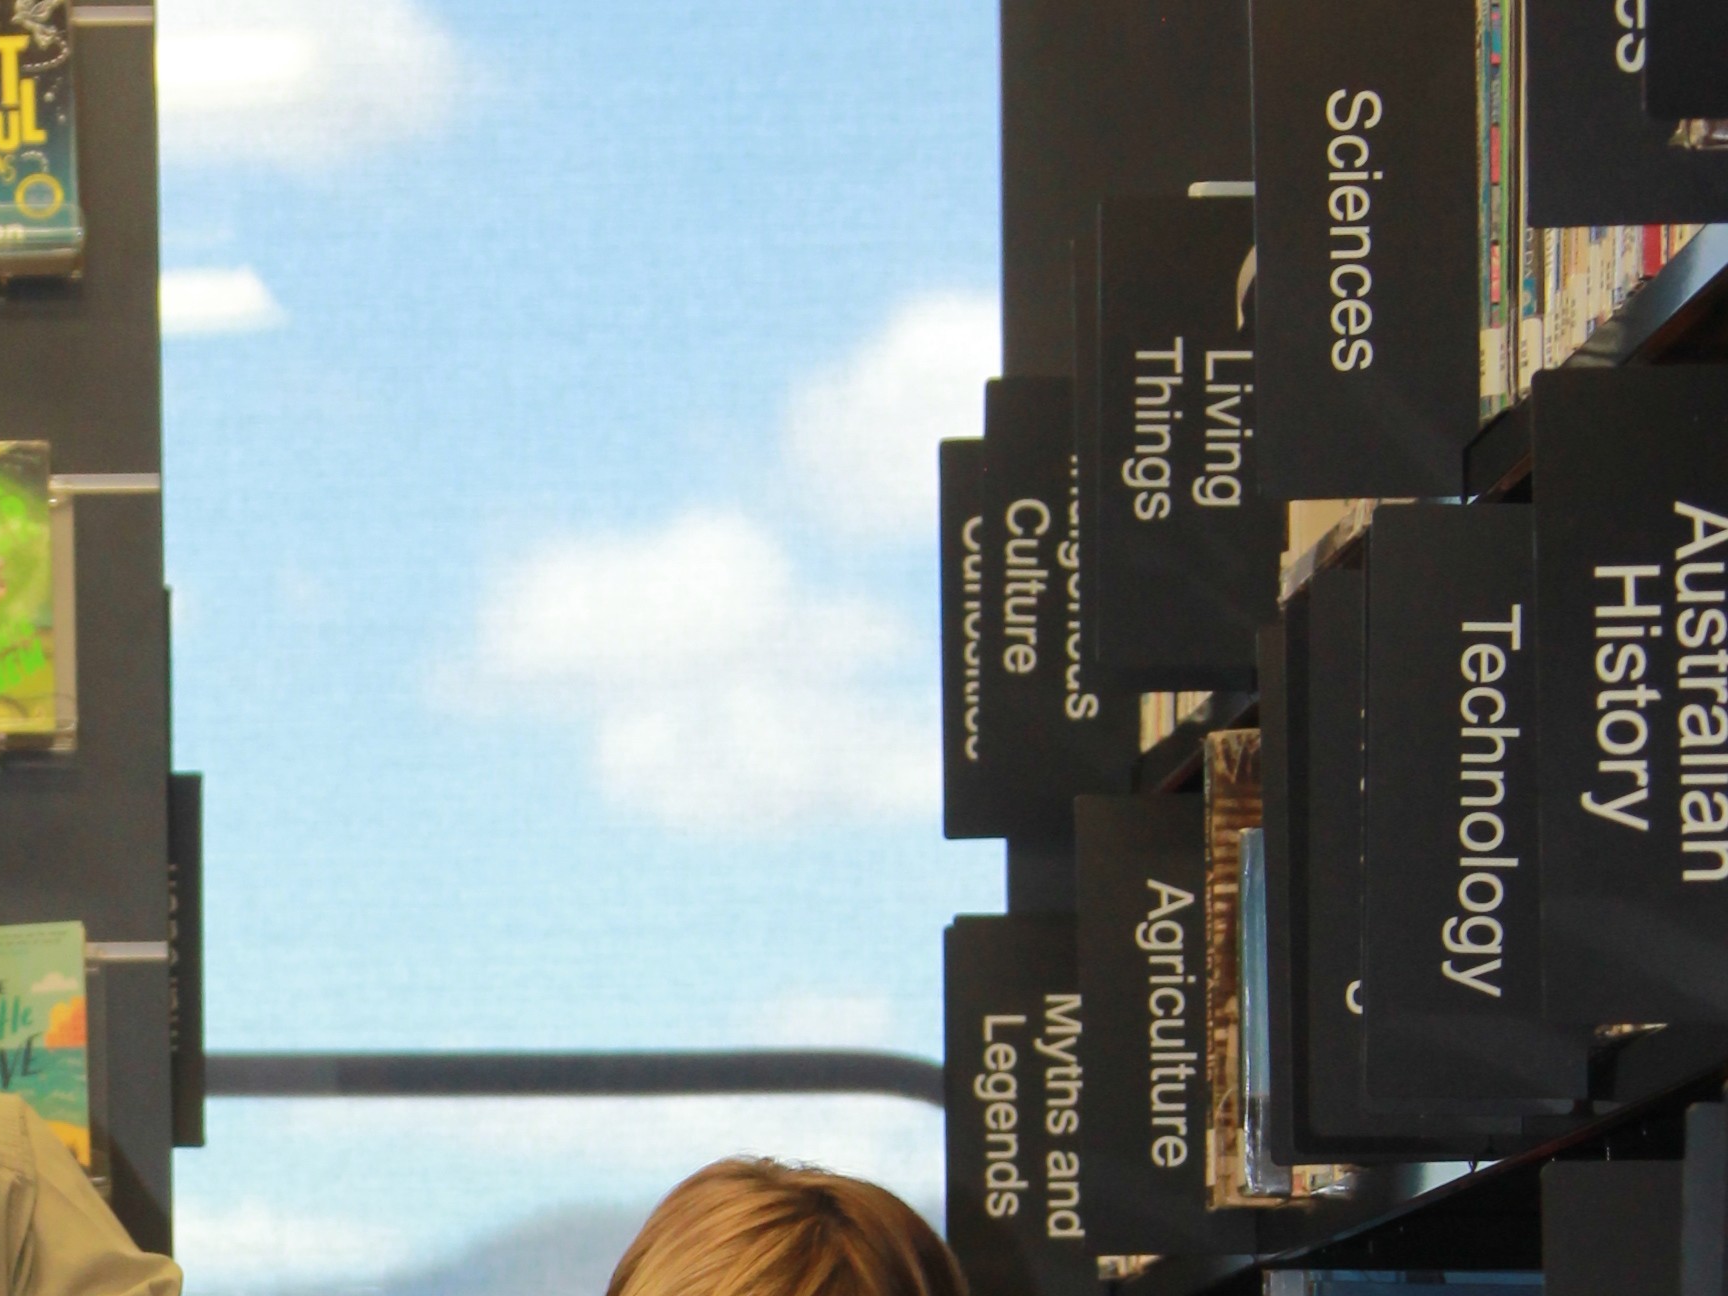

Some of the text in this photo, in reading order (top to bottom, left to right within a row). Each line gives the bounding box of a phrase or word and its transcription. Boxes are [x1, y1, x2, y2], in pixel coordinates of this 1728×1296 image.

[1326, 89, 1383, 372] Sciences
[1122, 336, 1183, 521] Things
[1192, 350, 1254, 506] Living
[1003, 498, 1051, 674] Culture
[1580, 565, 1662, 831] History
[1675, 501, 1728, 881] Australian
[1441, 603, 1522, 997] Technology
[974, 1014, 1028, 1217] Legends
[1034, 994, 1086, 1238] Myths and
[1136, 879, 1198, 1167] Agriculture
